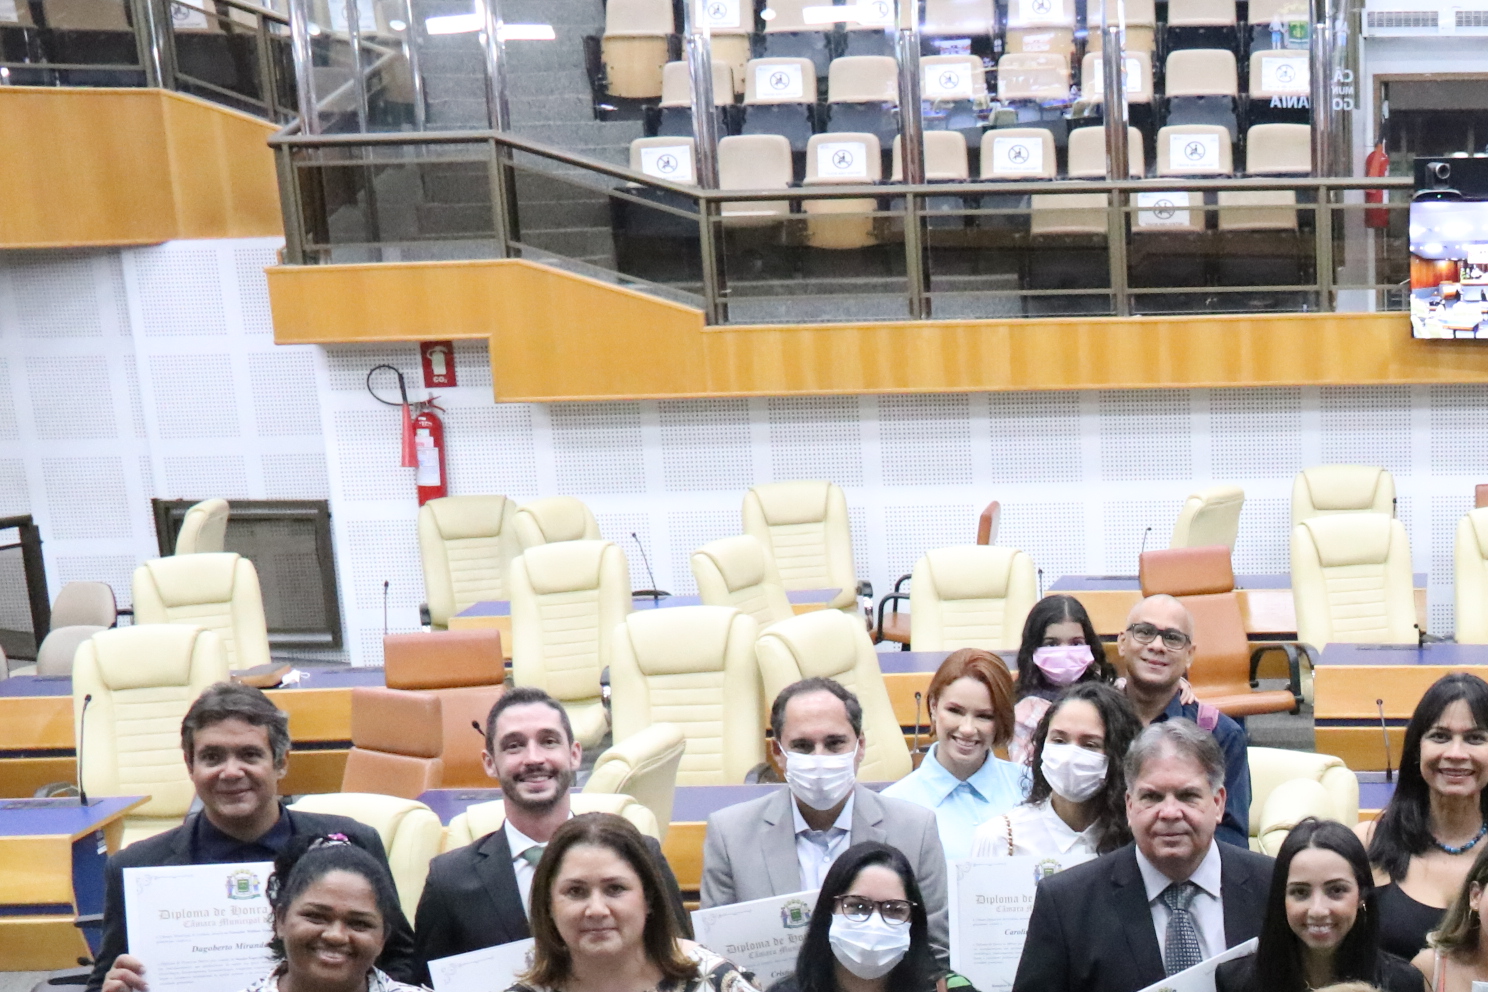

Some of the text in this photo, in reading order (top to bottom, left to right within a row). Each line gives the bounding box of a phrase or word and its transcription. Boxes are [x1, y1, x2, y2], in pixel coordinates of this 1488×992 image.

[976, 894, 1033, 905] Diploma de
[158, 905, 268, 920] Diploma de Honra
[192, 944, 232, 953] Dagoberto
